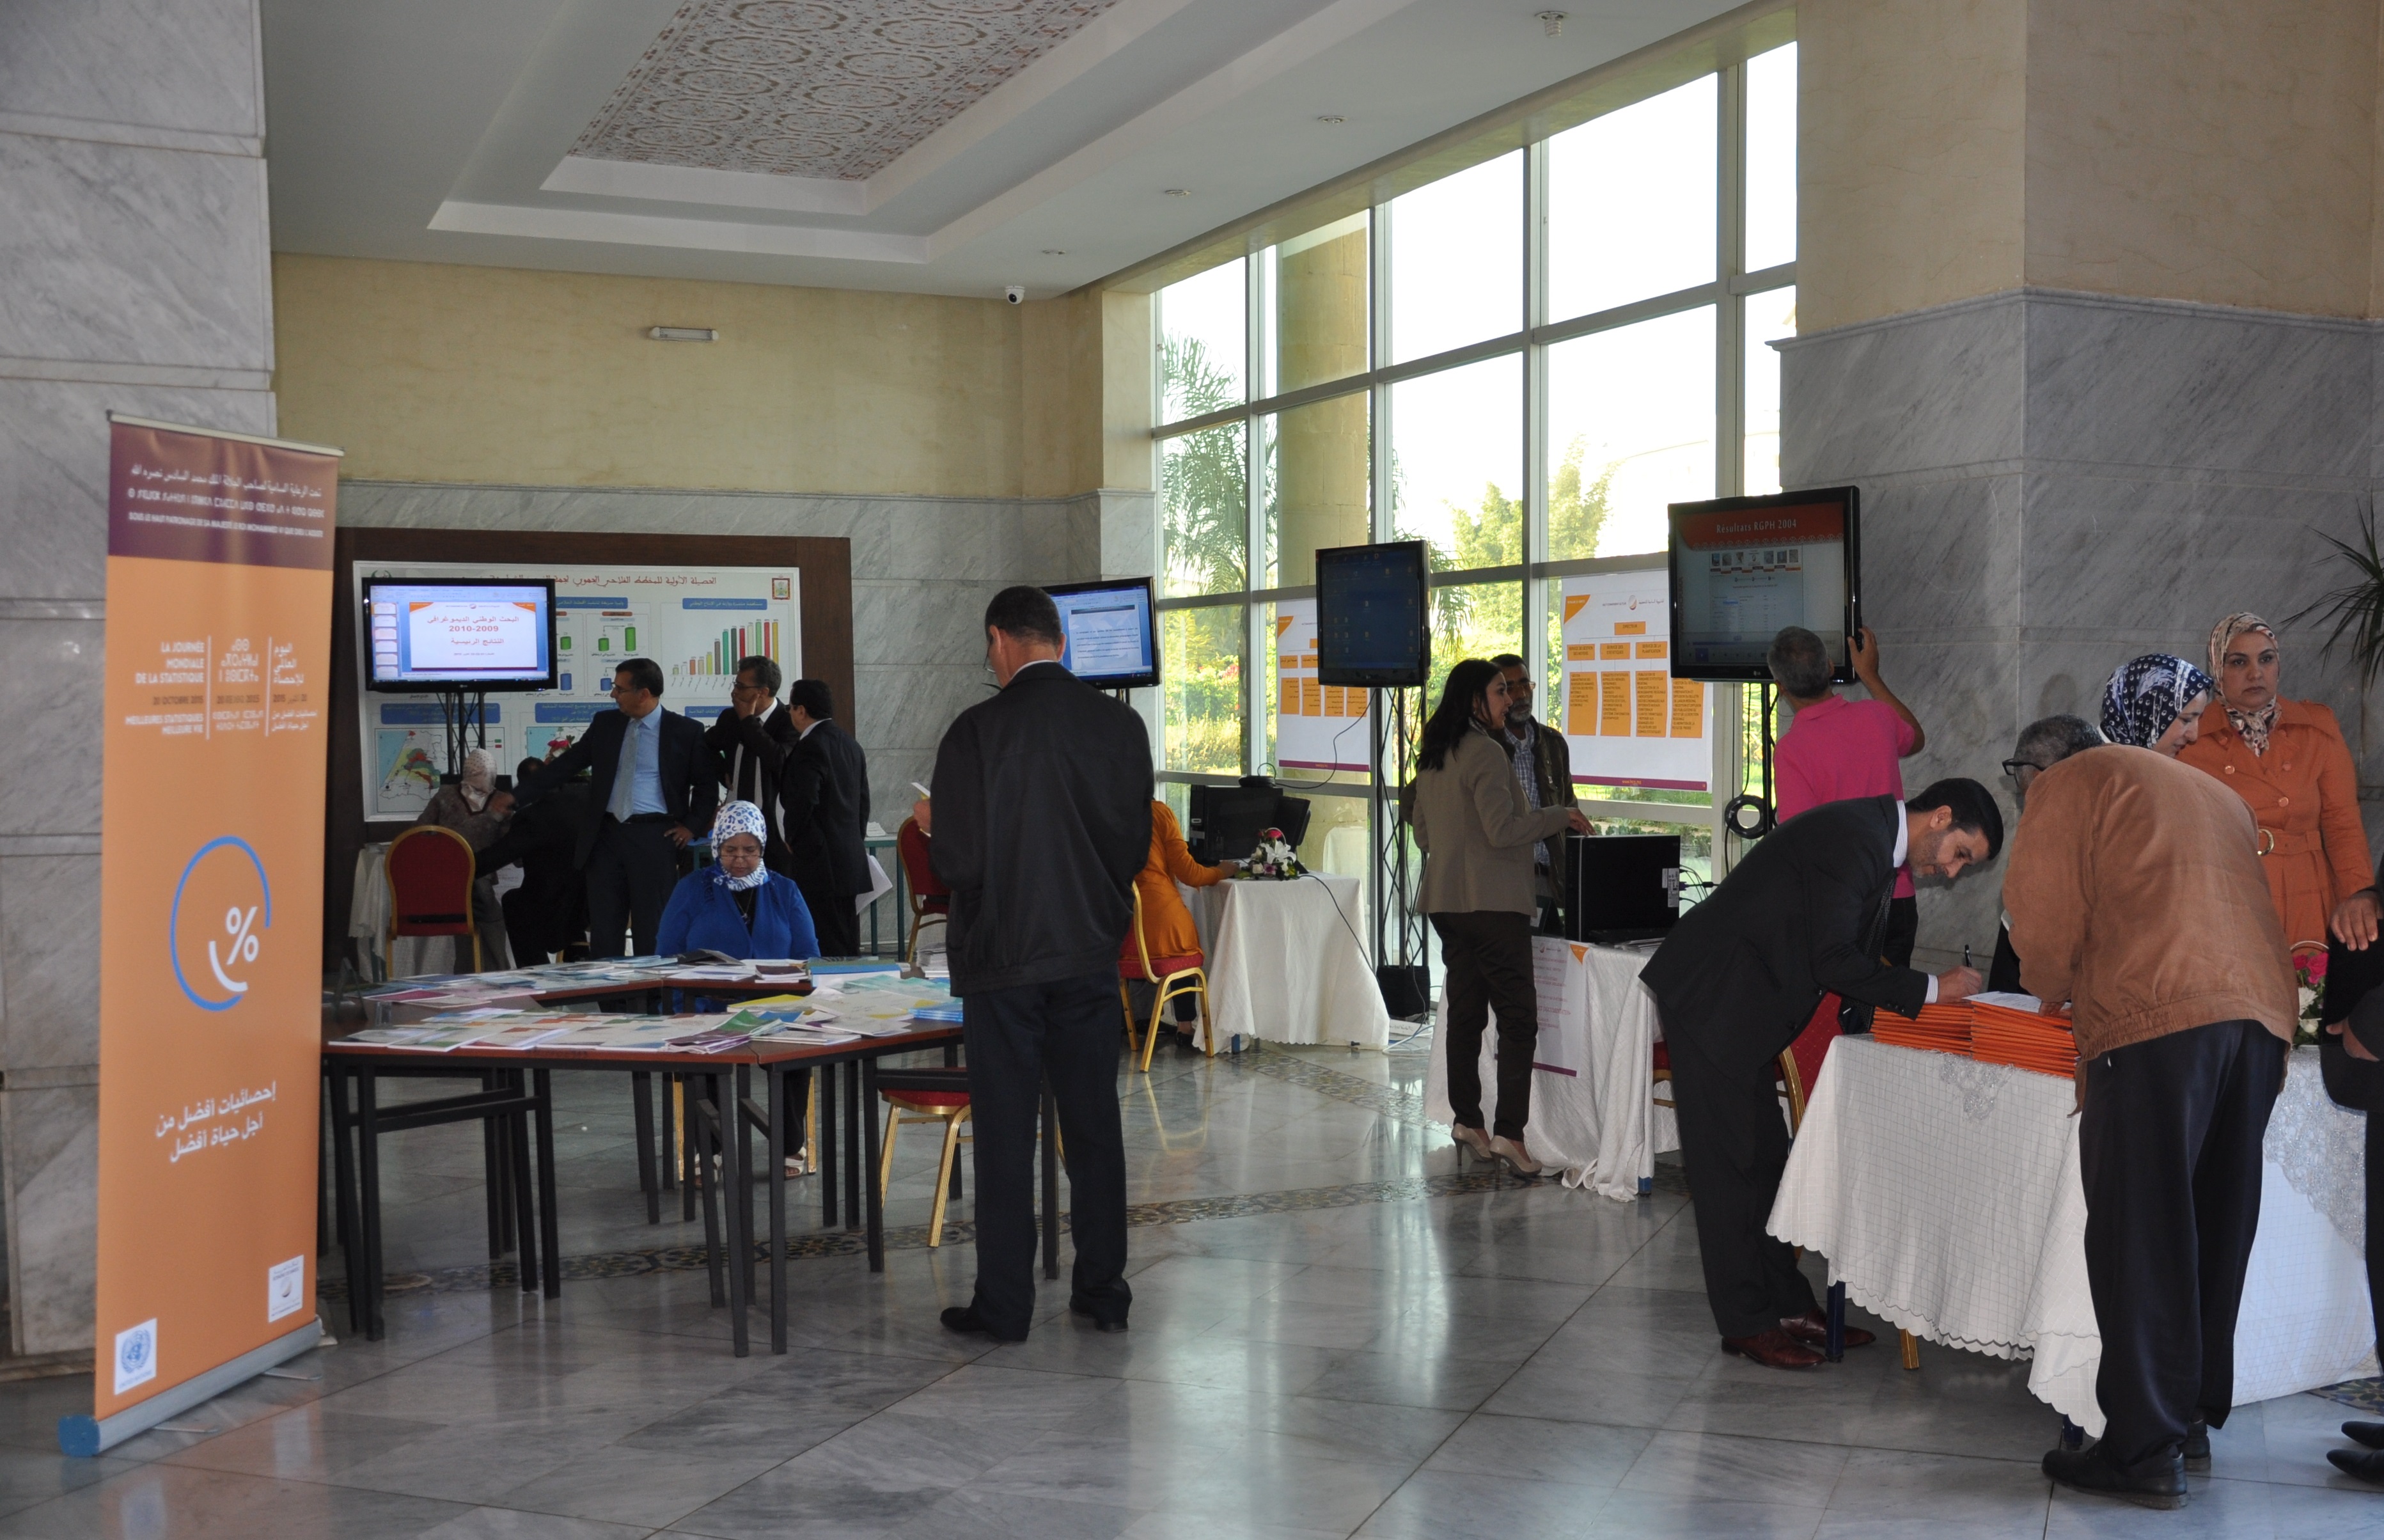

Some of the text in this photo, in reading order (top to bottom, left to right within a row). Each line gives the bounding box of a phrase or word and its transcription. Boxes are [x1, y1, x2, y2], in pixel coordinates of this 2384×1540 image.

[1716, 519, 1796, 533] Résultats RGPH 2004
[634, 576, 662, 585] للمخطط
[665, 575, 687, 586] الأولية
[691, 577, 716, 586] الحصيلة
[161, 640, 205, 652] LA JOURNÉE
[274, 643, 293, 657] اليوم
[166, 658, 205, 668] MONDIALE
[136, 672, 205, 684] DE LA STATISTIQUE
[156, 1081, 276, 1138] إحصائيات أفضل من
[169, 1111, 263, 1163] أجل حياة أفضل
